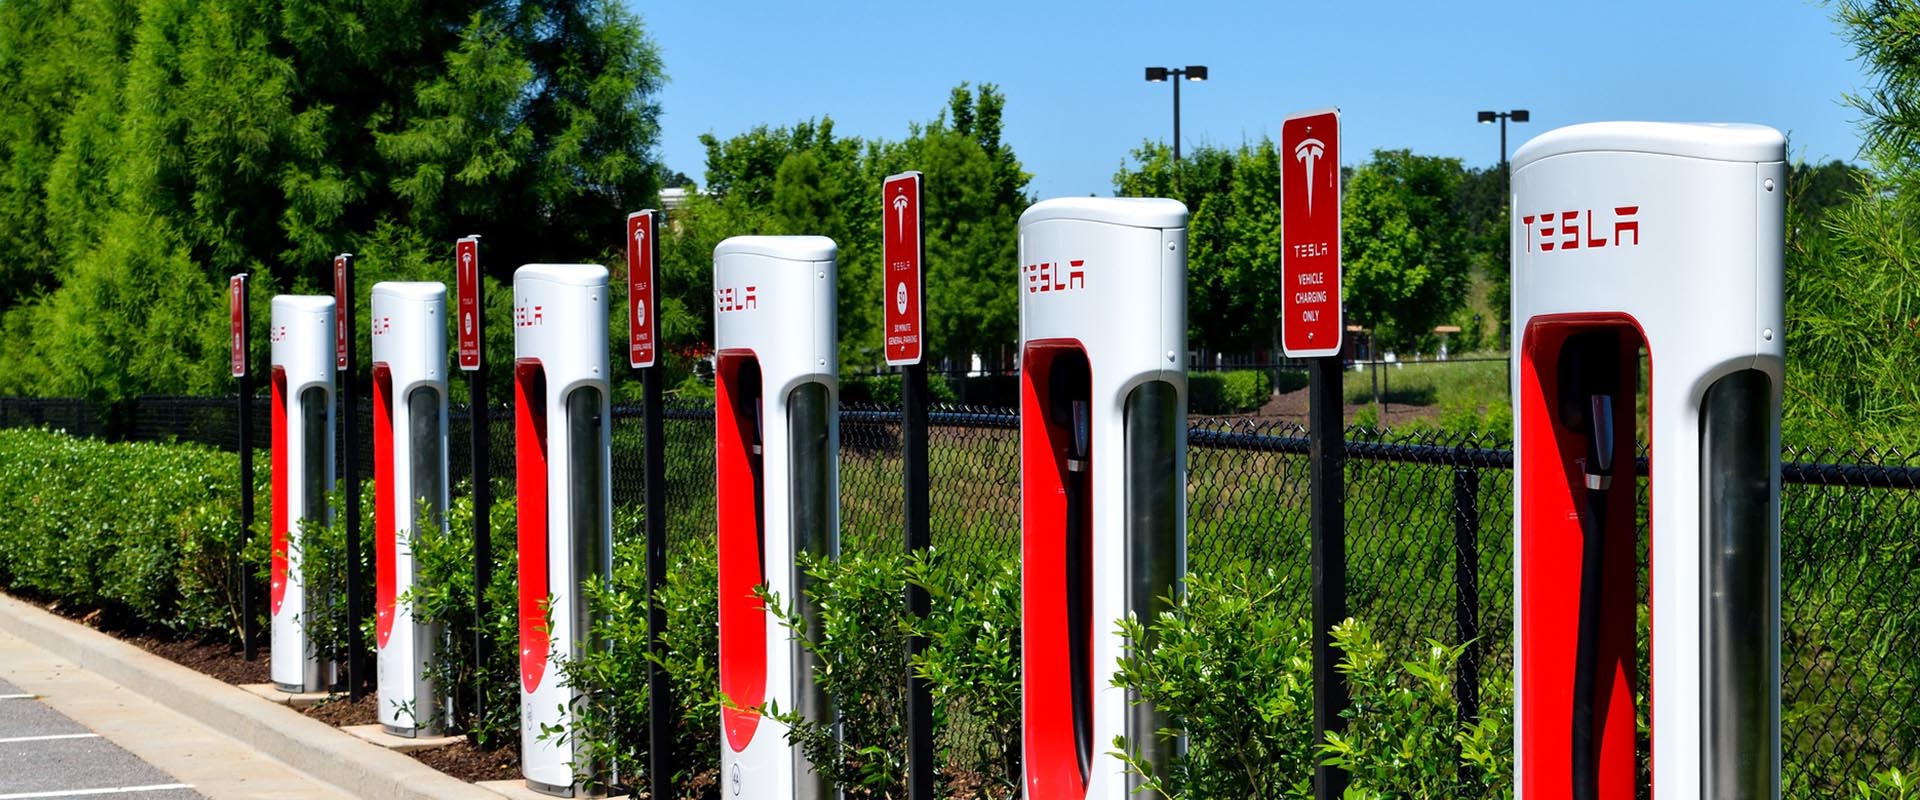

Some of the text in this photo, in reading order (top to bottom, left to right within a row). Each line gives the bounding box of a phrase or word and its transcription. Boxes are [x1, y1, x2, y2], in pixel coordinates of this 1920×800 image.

[1522, 206, 1639, 253] TESLA
[1294, 242, 1328, 258] TESLA
[893, 260, 911, 271] TESLA
[1298, 272, 1324, 285] VEHICLE
[1295, 291, 1327, 304] CHARGING
[1302, 310, 1320, 322] ONLY
